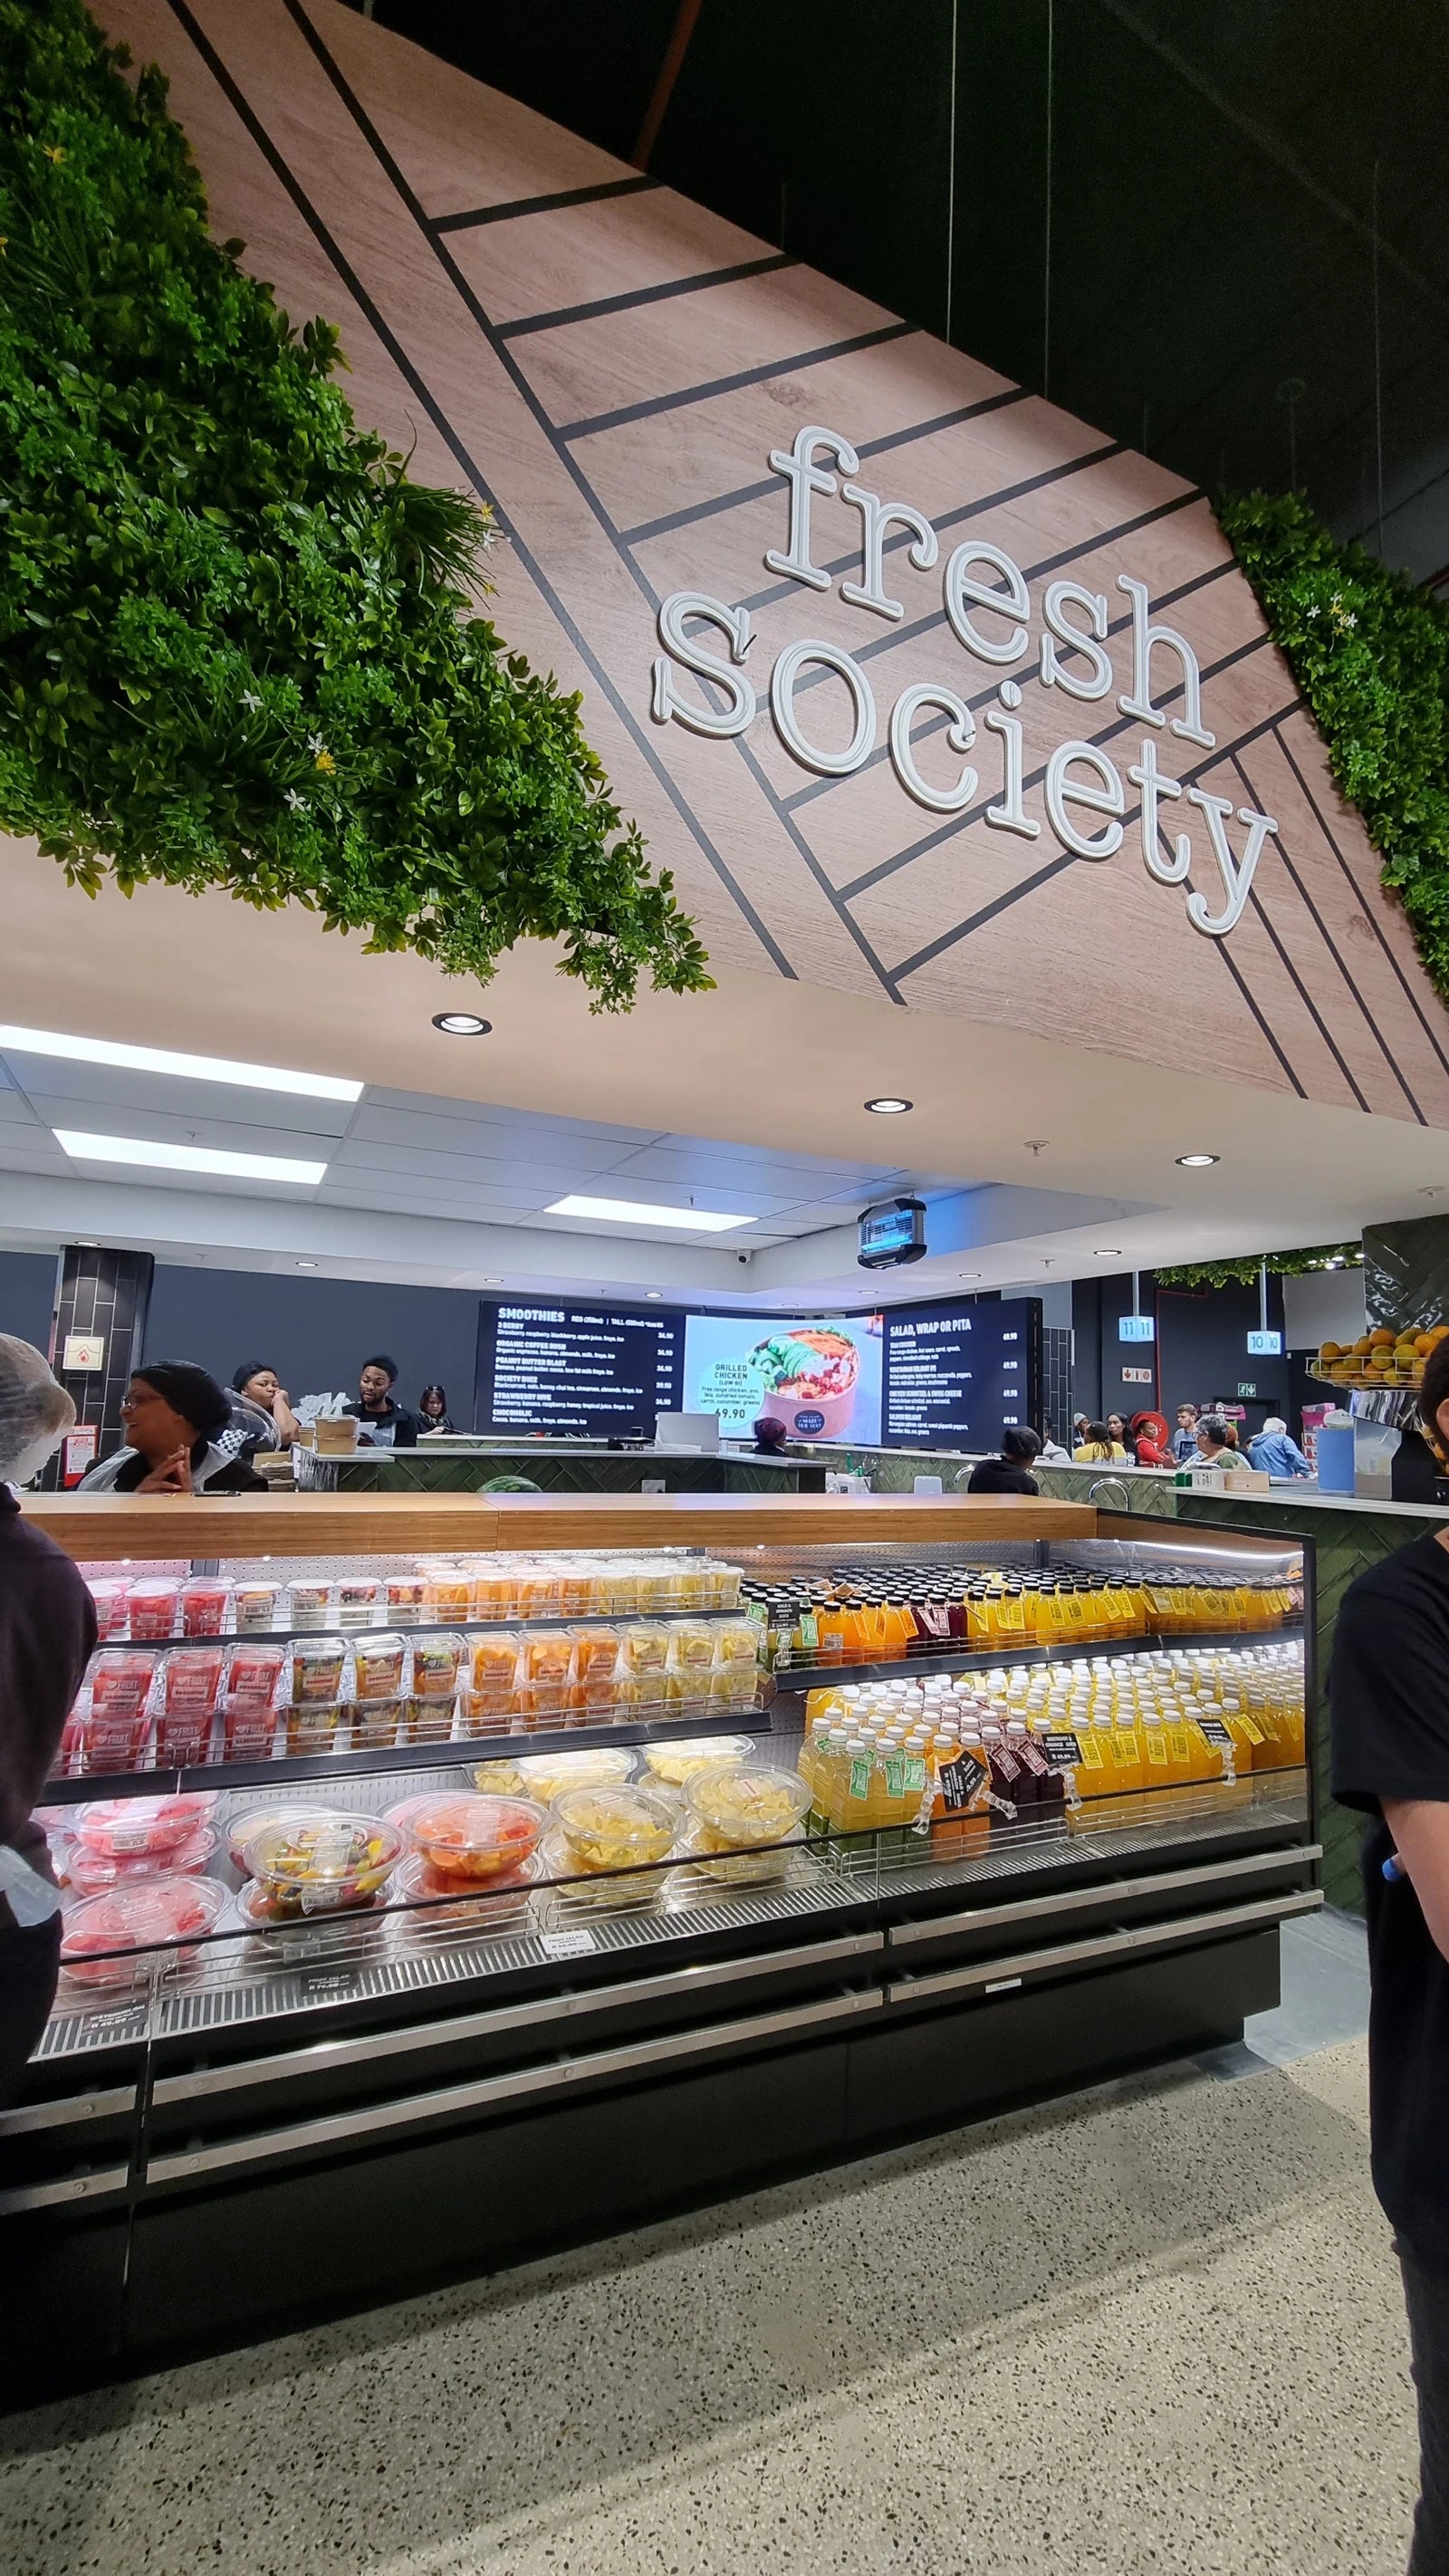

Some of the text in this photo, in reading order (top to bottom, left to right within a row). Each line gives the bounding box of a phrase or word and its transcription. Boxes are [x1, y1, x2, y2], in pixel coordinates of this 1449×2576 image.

[764, 425, 1215, 749] fresh
[652, 591, 1278, 936] society
[498, 1307, 565, 1322] SMOOTHIES
[889, 1318, 972, 1337] SALAD, WRAP OR PITA
[1123, 1322, 1133, 1336] 11
[1139, 1322, 1150, 1336] 11
[1251, 1336, 1263, 1349] 10
[1269, 1336, 1278, 1349] 10
[715, 1363, 747, 1371] GRILLED
[715, 1371, 748, 1379] CHICKEN
